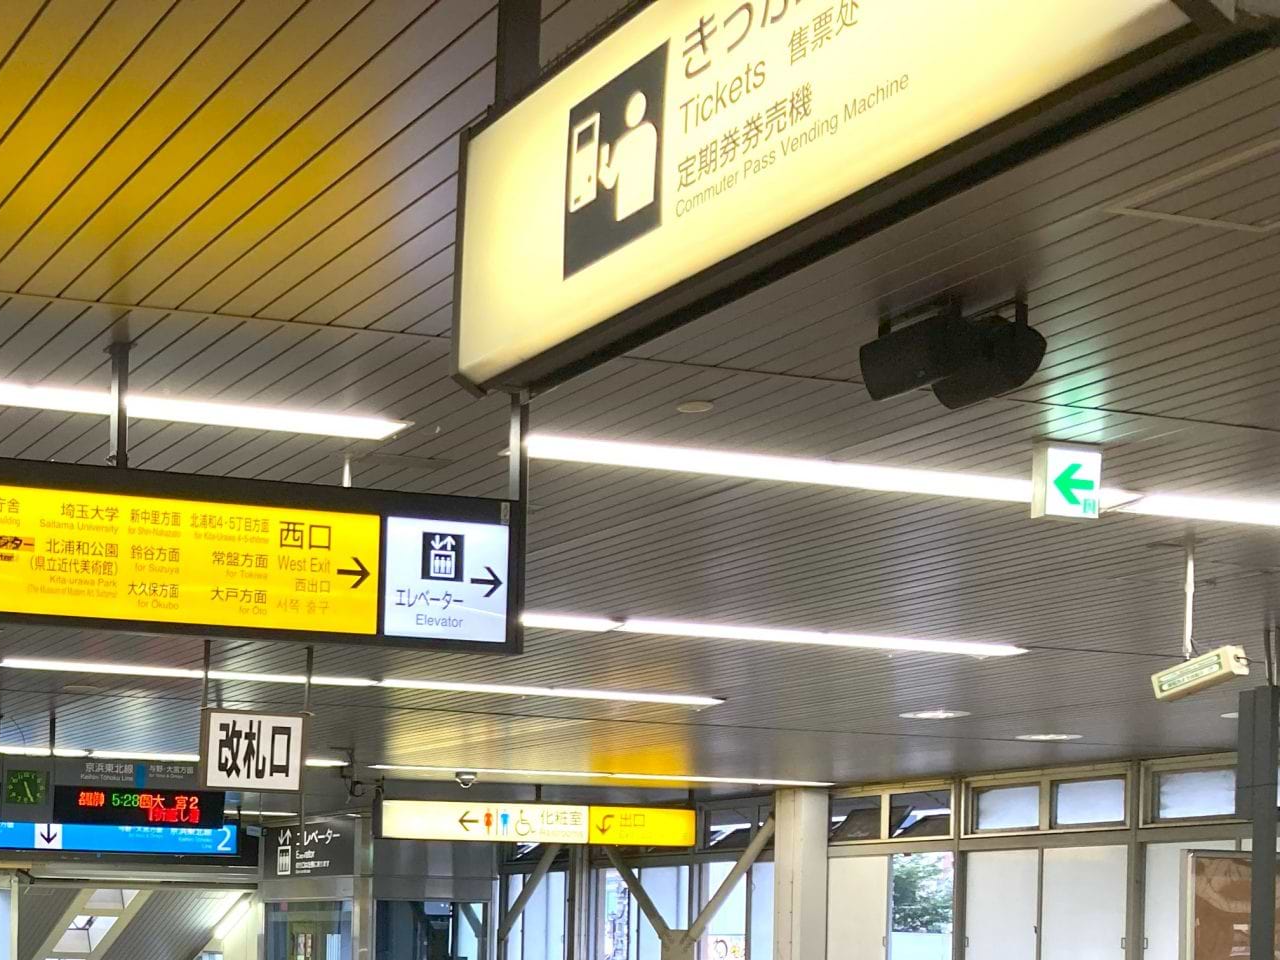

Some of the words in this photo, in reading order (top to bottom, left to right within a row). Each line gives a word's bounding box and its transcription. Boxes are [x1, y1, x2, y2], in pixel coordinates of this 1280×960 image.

[788, 0, 860, 66] 售票处
[679, 60, 766, 134] Tickets
[675, 170, 738, 218] Commuter
[743, 149, 776, 180] Pass
[781, 115, 838, 157] Vending
[844, 73, 909, 123] Machine
[677, 81, 813, 192] 定期券券売機
[61, 503, 119, 521] 埼玉大学
[130, 508, 182, 527] 新中里方面
[40, 518, 74, 530] Saitama
[77, 521, 119, 535] University
[279, 521, 332, 551] 西口
[46, 539, 119, 558] 北浦和公園
[130, 545, 180, 563] 鈴谷方面
[212, 551, 269, 569] 常盤方面
[278, 555, 306, 573] West
[310, 558, 331, 574] Exit
[97, 576, 117, 588] Park
[128, 582, 179, 599] 大久保方面
[294, 578, 332, 593] 西出口
[211, 586, 268, 605] 大戸方面
[395, 588, 464, 610] エレベーター
[415, 614, 464, 629] Elevator
[219, 720, 293, 780] 改札口
[111, 793, 140, 807] 5:28
[189, 796, 199, 810] 2
[540, 809, 583, 827] 化粧室
[620, 813, 646, 828] 出口
[217, 827, 232, 851] 2
